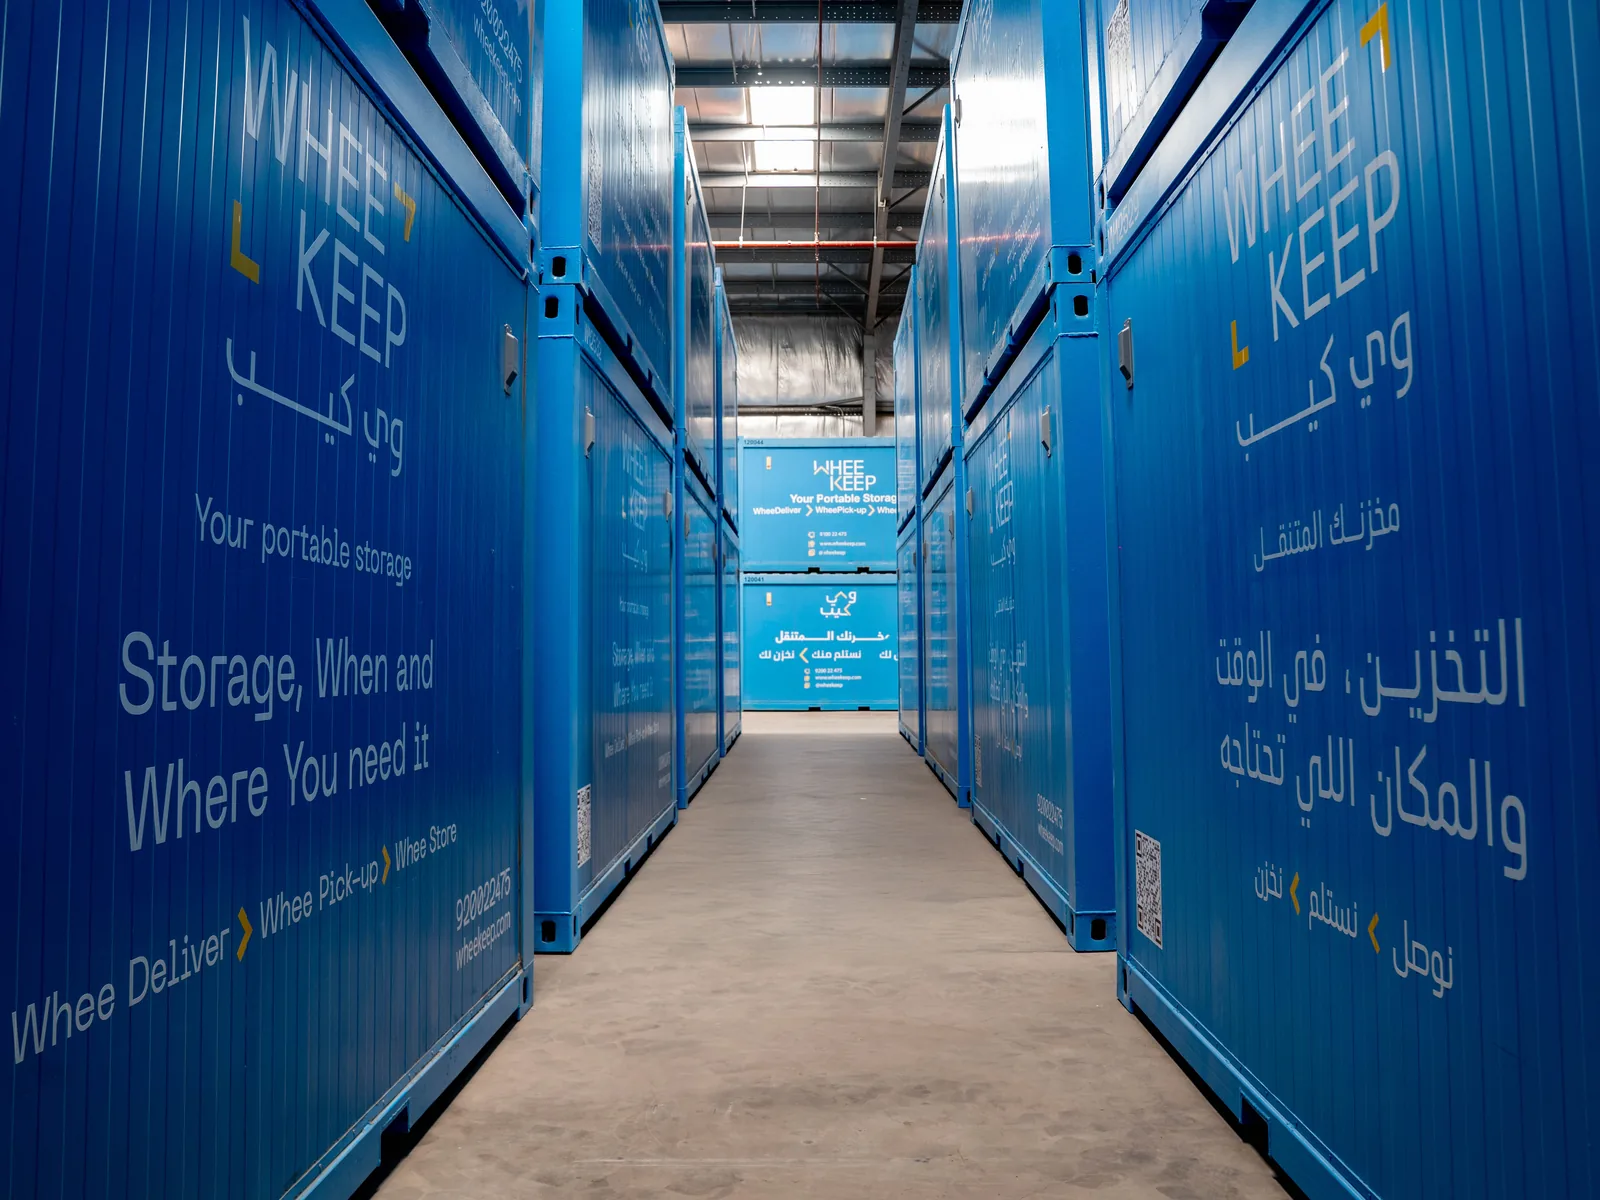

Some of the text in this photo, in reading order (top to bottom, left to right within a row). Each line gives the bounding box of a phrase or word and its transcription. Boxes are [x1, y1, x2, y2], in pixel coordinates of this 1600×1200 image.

[481, 0, 522, 83] 20022475
[243, 15, 387, 255] WHEE
[1223, 47, 1355, 264] WHEE
[297, 209, 407, 368] KEEP
[1268, 149, 1400, 341] KEEP
[226, 336, 403, 477] وي كيب
[1236, 311, 1413, 461] وي كيب
[753, 507, 801, 515] WheeDeliver
[815, 506, 867, 515] WheePick-up
[790, 494, 814, 504] Your
[817, 493, 860, 503] Portable
[813, 460, 864, 475] WHEE
[830, 476, 876, 491] KEEP
[195, 493, 411, 587] Your portable storage
[119, 631, 433, 721] Storage, When and
[1216, 630, 1272, 703] الوقت
[1283, 634, 1326, 723] في
[125, 721, 429, 851] Where You need it
[1370, 745, 1527, 880] والمكان
[12, 823, 456, 1064] Whee Deliver Whee Pick-up Whee Store
[456, 867, 511, 931] 920022475
[456, 911, 511, 971] wheekeep.com
